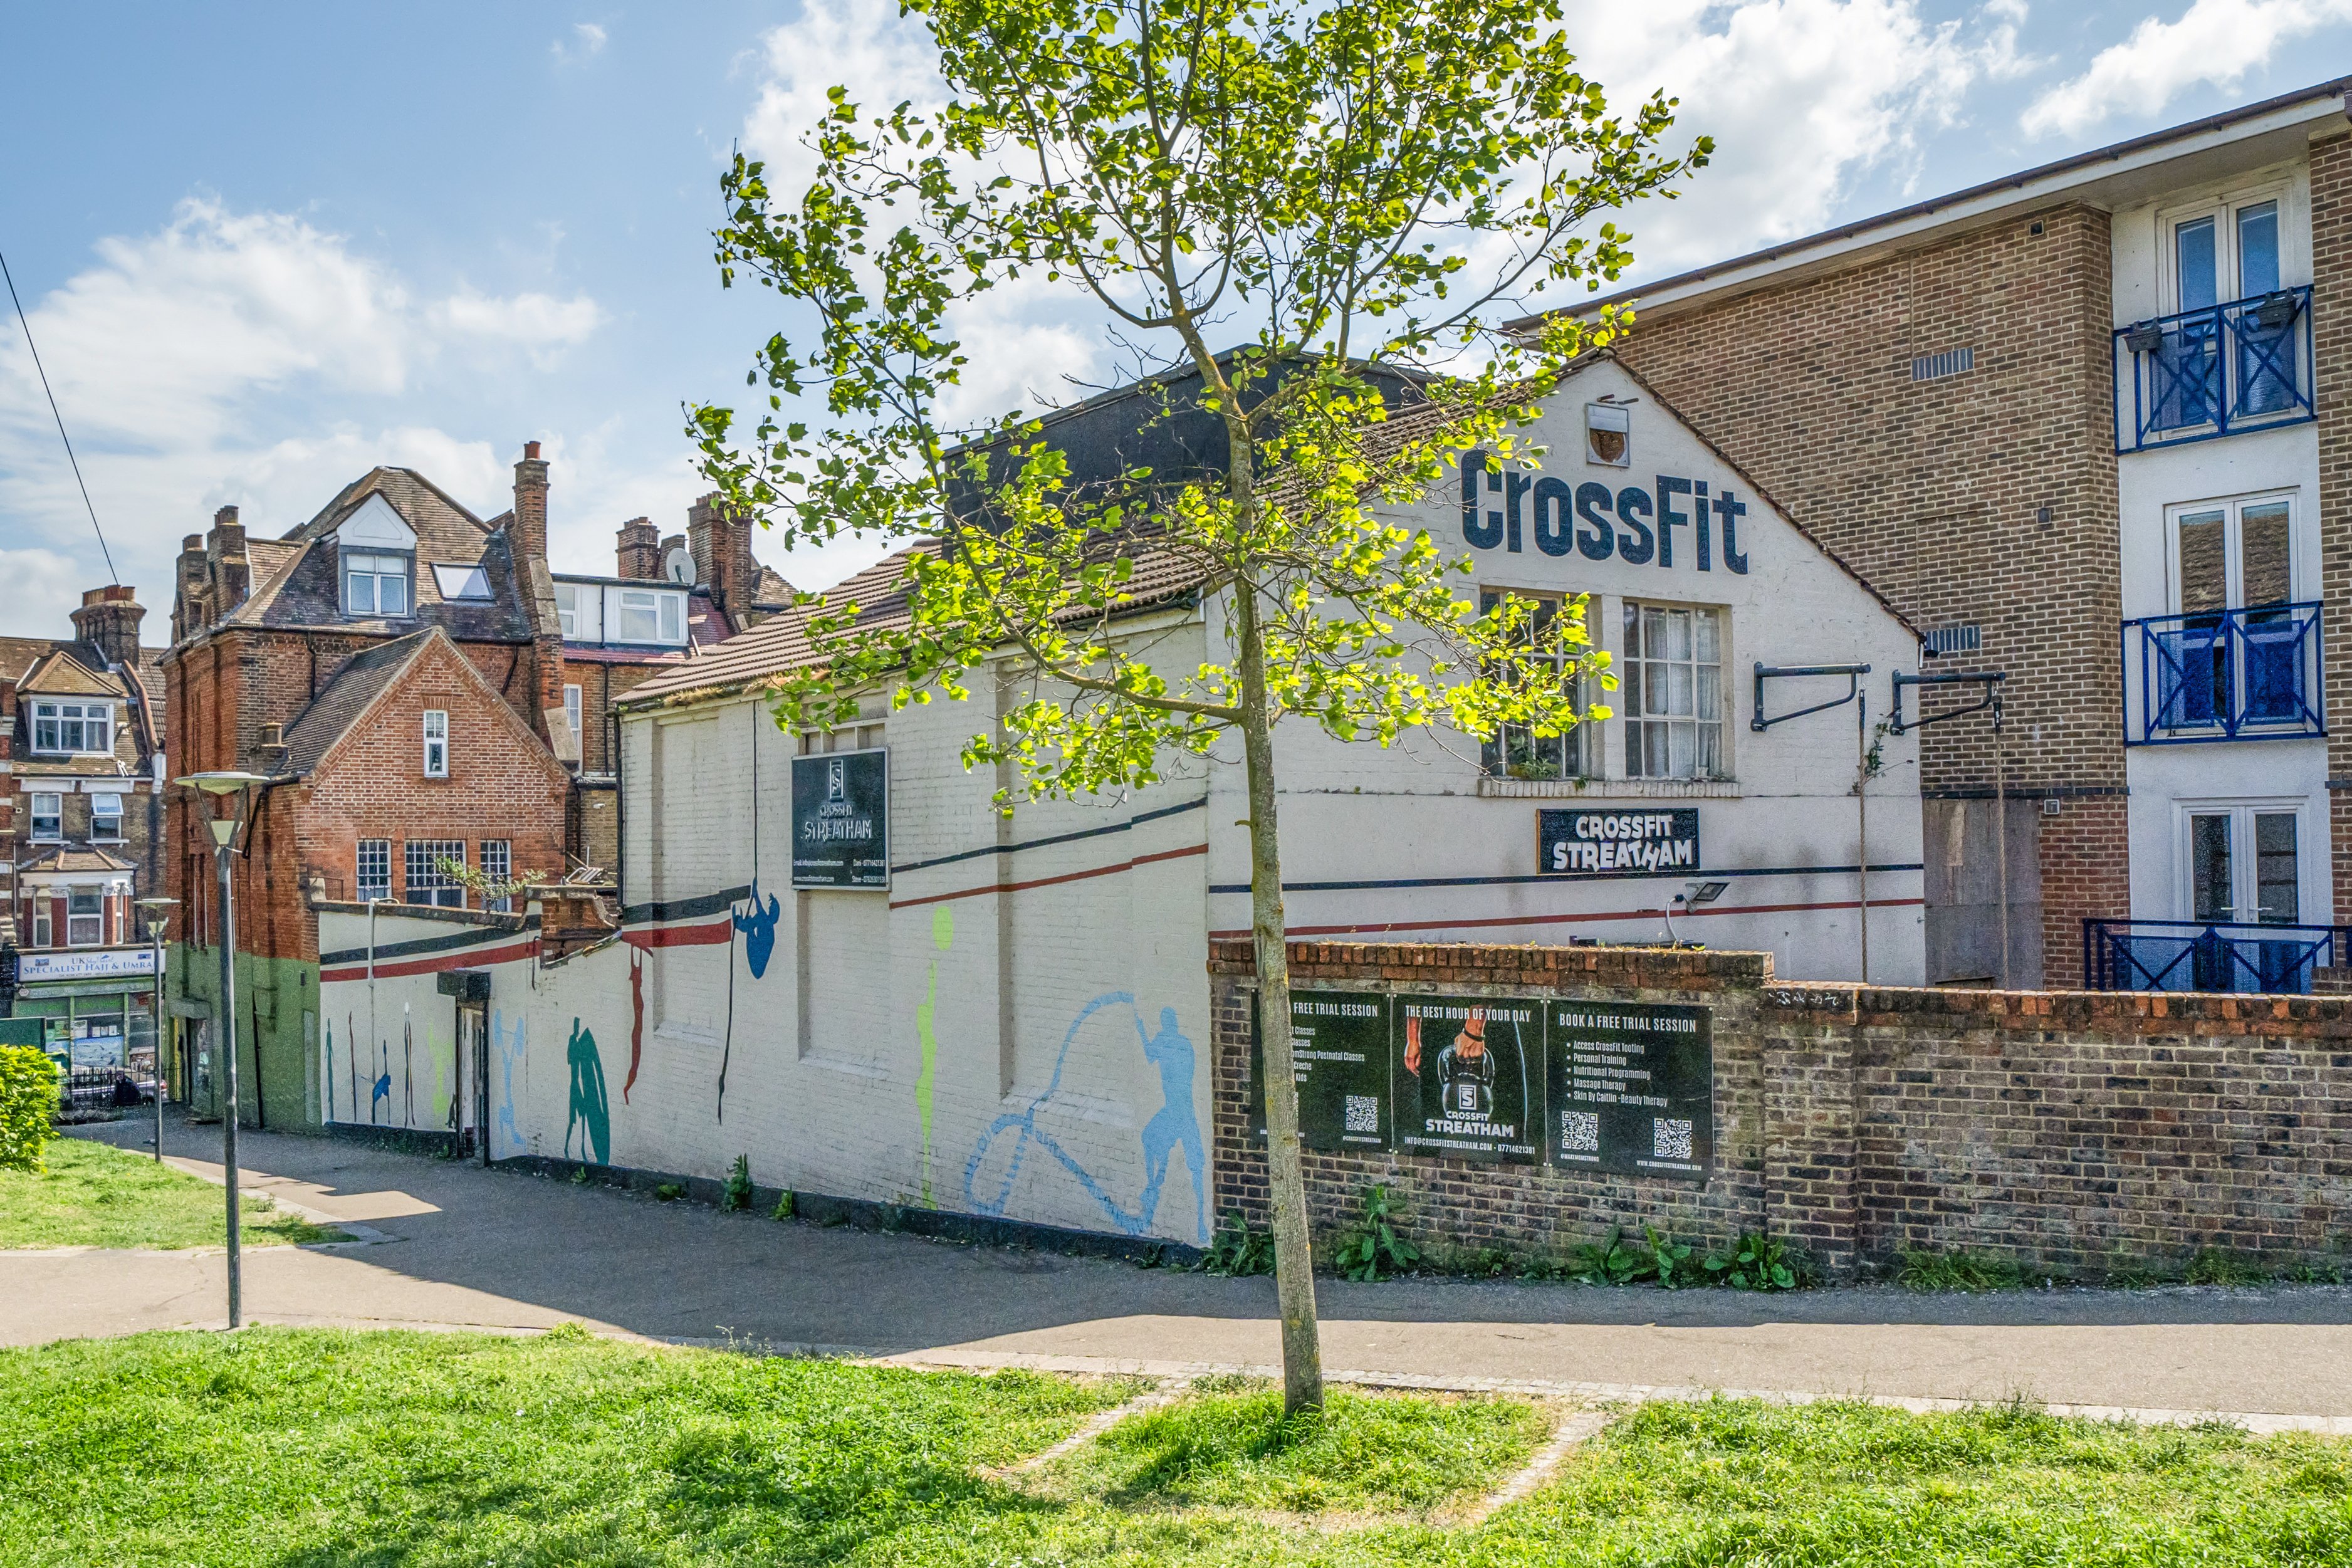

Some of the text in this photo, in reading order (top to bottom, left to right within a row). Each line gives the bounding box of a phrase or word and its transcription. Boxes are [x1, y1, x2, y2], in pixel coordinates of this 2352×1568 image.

[1461, 449, 1748, 575] CrossFit
[805, 819, 872, 842] STREATHAM
[1576, 815, 1673, 840] CROSSFIT
[1553, 840, 1692, 872] STREATHAM
[24, 965, 81, 975] SPECIALIST
[1294, 1002, 1378, 1017] FREE TRIAL SESSION
[1405, 1005, 1531, 1022] THE BEST HOUR OF YOUR DAY
[1559, 1013, 1696, 1032] BOOK A FREE TRIAL SESSION
[1295, 1026, 1315, 1035] Classes
[1573, 1040, 1644, 1054] Access CrossFit Tooting
[1317, 1050, 1343, 1060] Postnatal
[1344, 1052, 1365, 1062] Classes
[1574, 1053, 1626, 1065] Personal Training
[1294, 1061, 1312, 1070] Creche
[1574, 1065, 1650, 1080] Nutritional Programming
[1295, 1072, 1307, 1082] Kids
[1574, 1078, 1626, 1091] Massage Therapy
[1574, 1090, 1587, 1100] Skin
[1588, 1092, 1596, 1102] By
[1596, 1092, 1617, 1103] Caitlin
[1643, 1095, 1668, 1107] Therapy
[1446, 1111, 1490, 1122] CROSSFIT
[1426, 1119, 1514, 1137] STREATHAM
[1404, 1136, 1492, 1151] INFO@CROSSFITSTREATHAM.COM
[1498, 1144, 1535, 1154] 07714621381
[1636, 1160, 1702, 1171] WWW.CROSSFITSTREATHAM.COM
